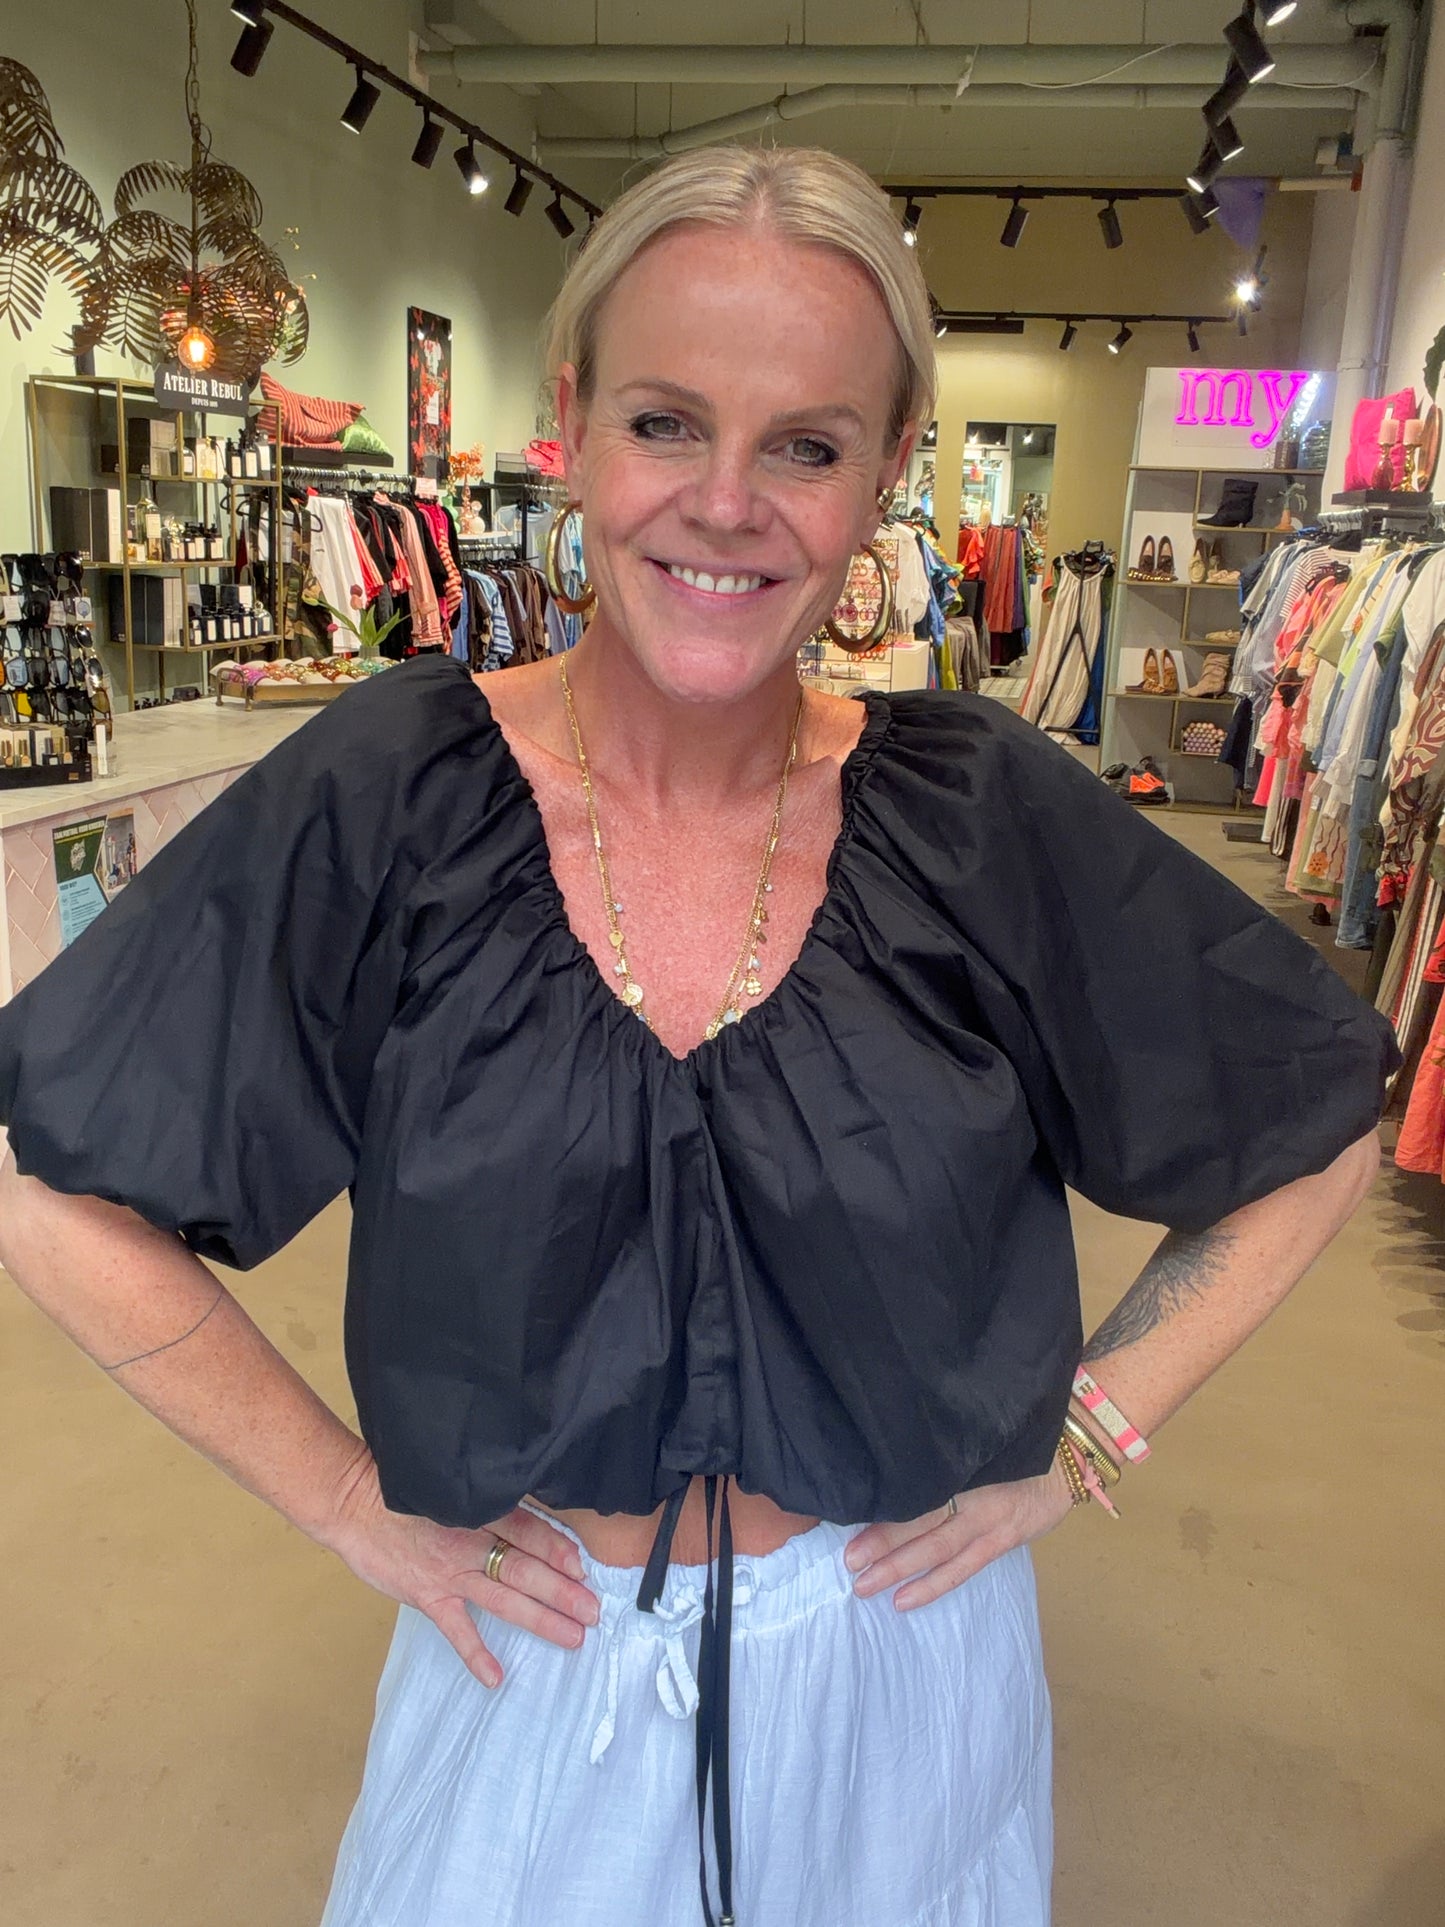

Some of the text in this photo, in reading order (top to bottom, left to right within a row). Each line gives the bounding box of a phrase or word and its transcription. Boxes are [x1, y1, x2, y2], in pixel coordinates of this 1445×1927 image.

[163, 371, 243, 401] ATELIER REBUL
[1175, 368, 1309, 449] my
